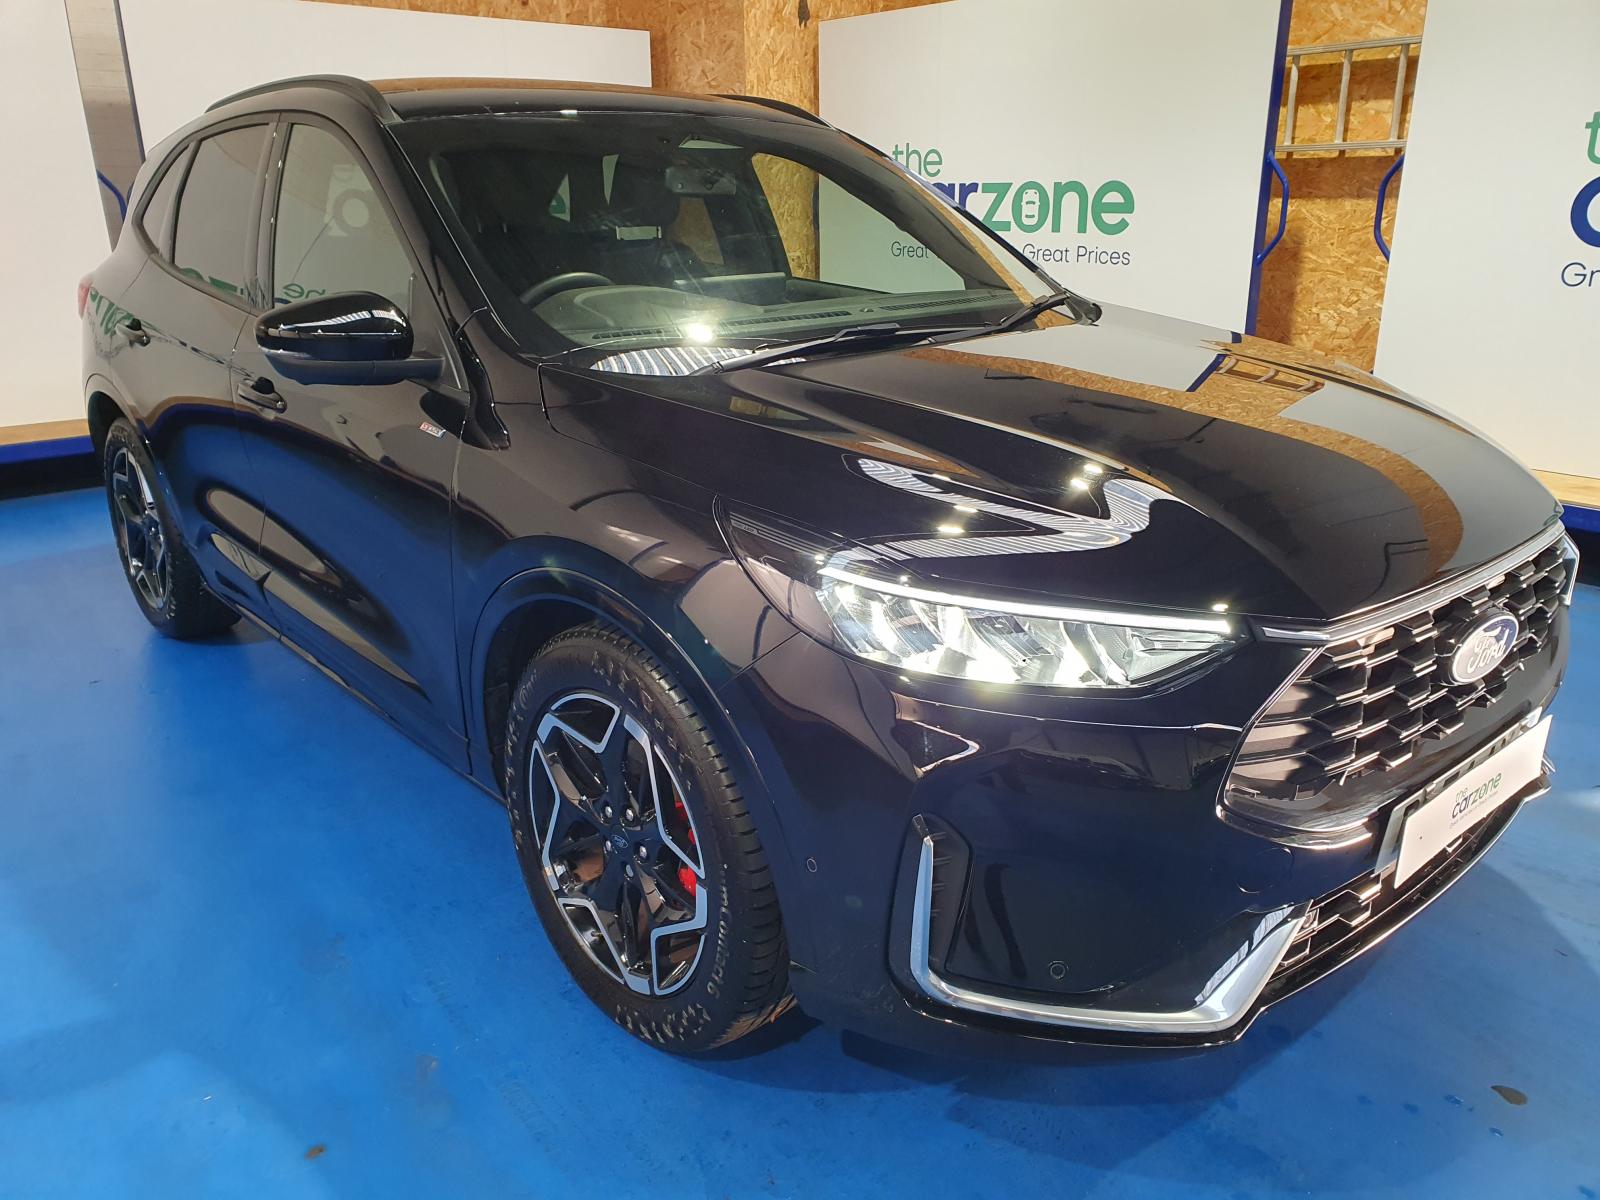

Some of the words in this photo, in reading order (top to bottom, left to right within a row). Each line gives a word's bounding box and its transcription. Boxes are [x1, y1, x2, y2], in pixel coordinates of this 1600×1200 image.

[892, 142, 942, 177] the
[932, 179, 1135, 235] rzone
[1022, 243, 1069, 263] Great
[1076, 245, 1131, 265] Prices
[1452, 772, 1502, 818] carzone
